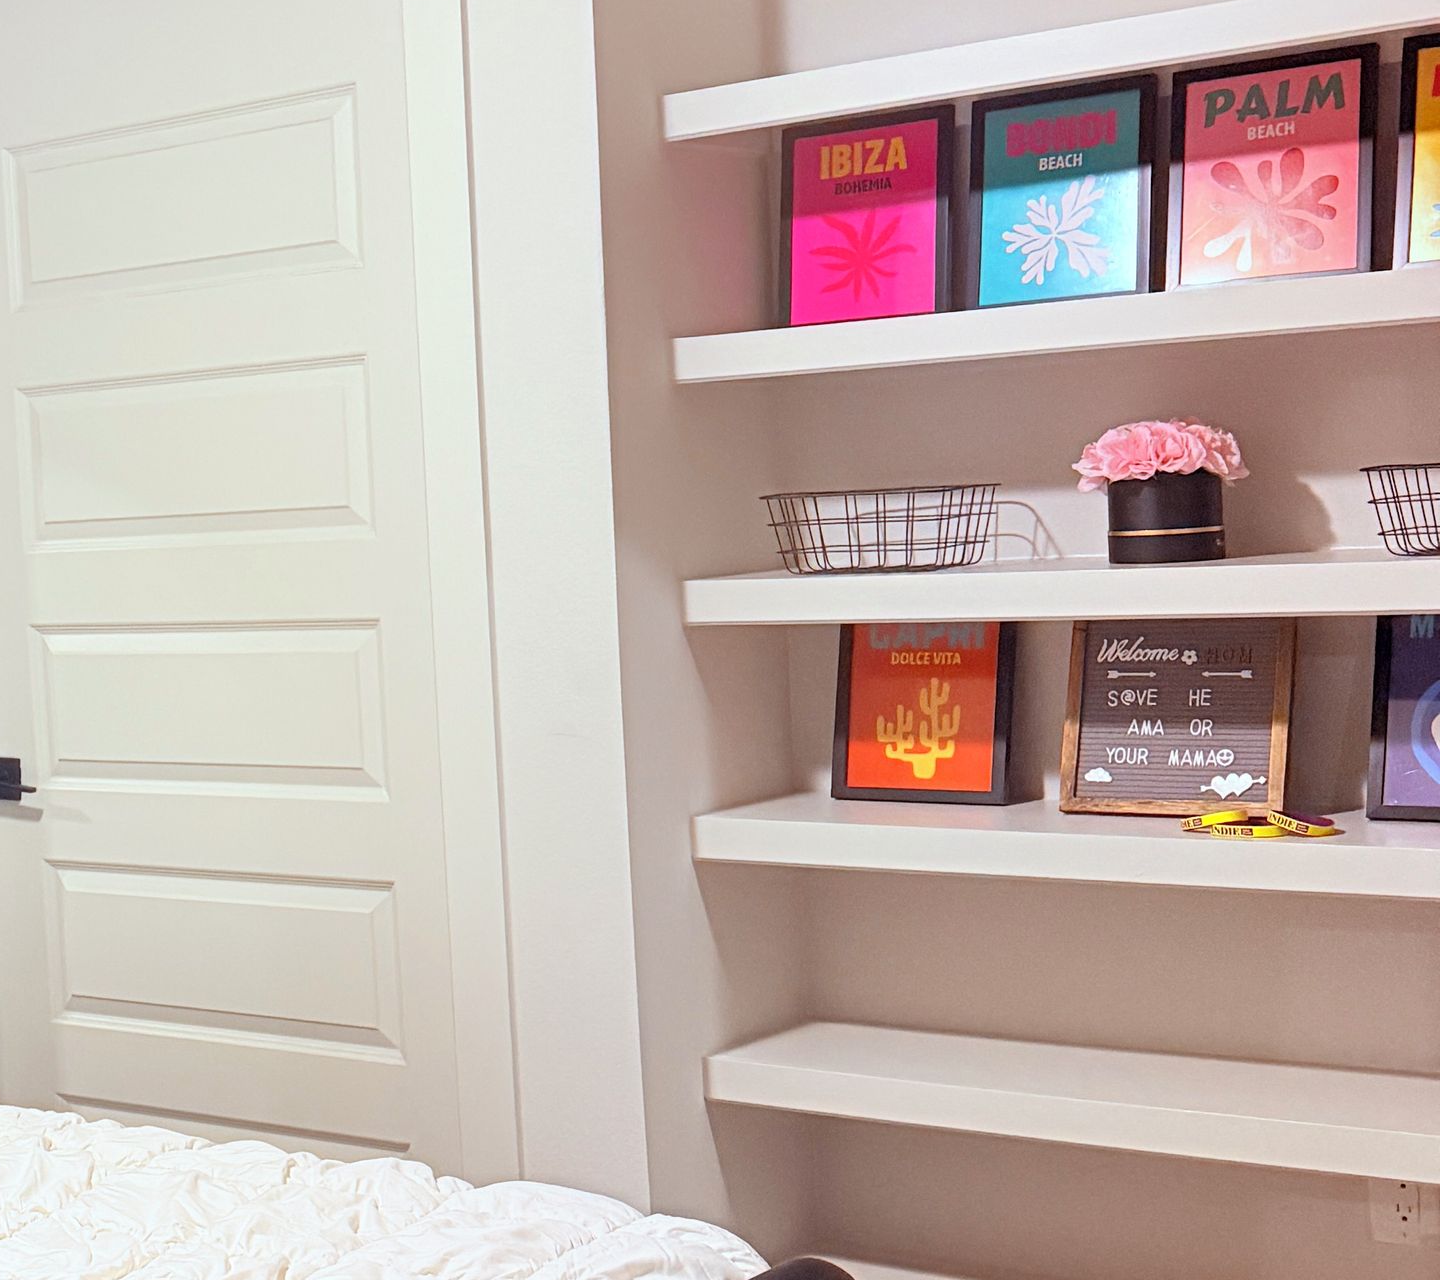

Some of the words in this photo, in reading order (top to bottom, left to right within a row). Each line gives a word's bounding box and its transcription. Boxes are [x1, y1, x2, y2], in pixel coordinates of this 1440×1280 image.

[1203, 72, 1345, 128] PALM
[1247, 121, 1296, 141] BEACH
[820, 136, 908, 180] IBIZA
[1039, 152, 1083, 171] BEACH
[834, 177, 892, 195] BOHEMIA
[891, 651, 930, 666] DOLCE
[933, 651, 962, 666] VITA
[1097, 636, 1179, 663] Welcome
[1107, 689, 1158, 707] S@VE
[1188, 689, 1211, 707] HE
[1126, 719, 1164, 737] AMA
[1190, 718, 1213, 736] OR
[1106, 747, 1148, 765] YOUR
[1168, 750, 1218, 767] MAMA
